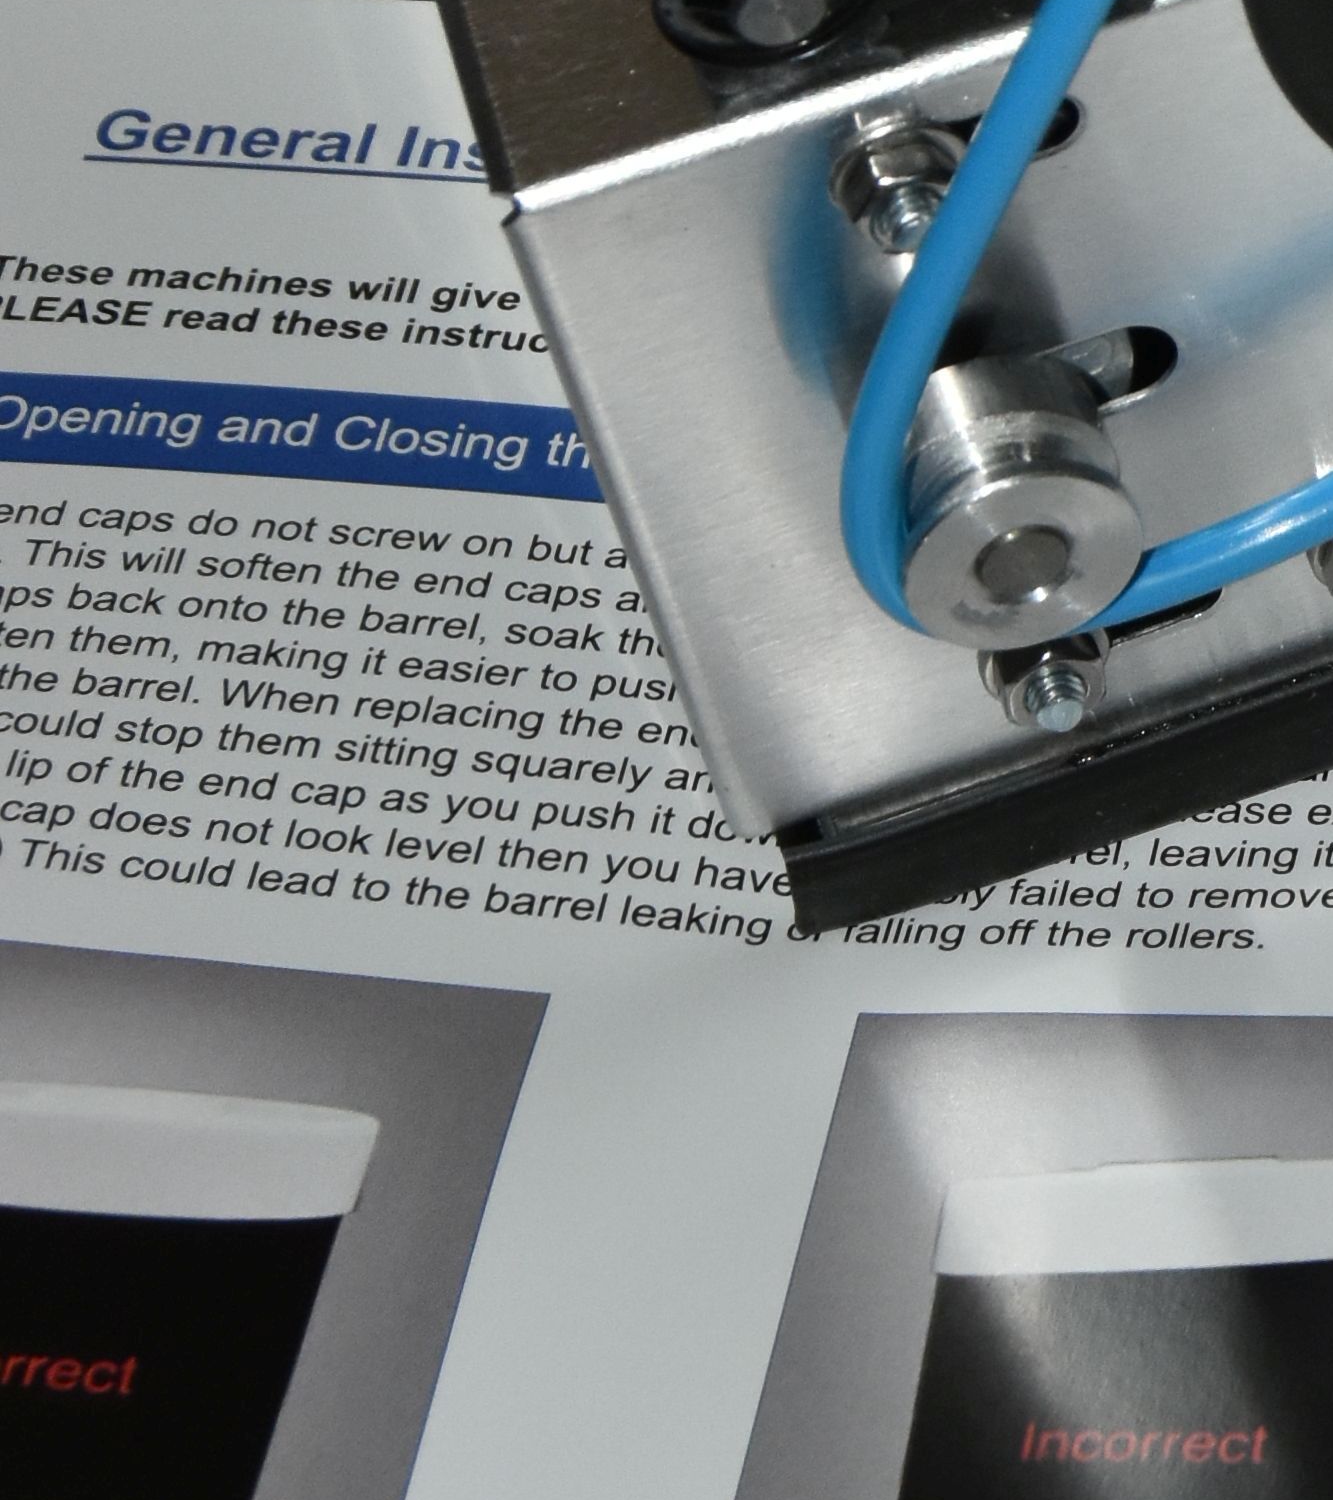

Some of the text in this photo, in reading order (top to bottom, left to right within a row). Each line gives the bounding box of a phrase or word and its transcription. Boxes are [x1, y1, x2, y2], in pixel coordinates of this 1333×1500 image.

[95, 107, 488, 172] General Ins
[0, 253, 522, 315] These machines will give
[0, 294, 553, 353] LEASE read these instruc
[0, 393, 591, 473] Opening and Closing th
[21, 837, 107, 876] This
[118, 855, 237, 889] could
[245, 860, 340, 899] lead
[351, 871, 392, 903] to
[404, 875, 471, 911] the
[483, 882, 610, 924] barrel
[619, 894, 774, 947] leaking
[978, 917, 1039, 947] off
[1046, 919, 1113, 949] the
[1124, 921, 1265, 951] rollers.
[1020, 1421, 1269, 1466] Incorrect
